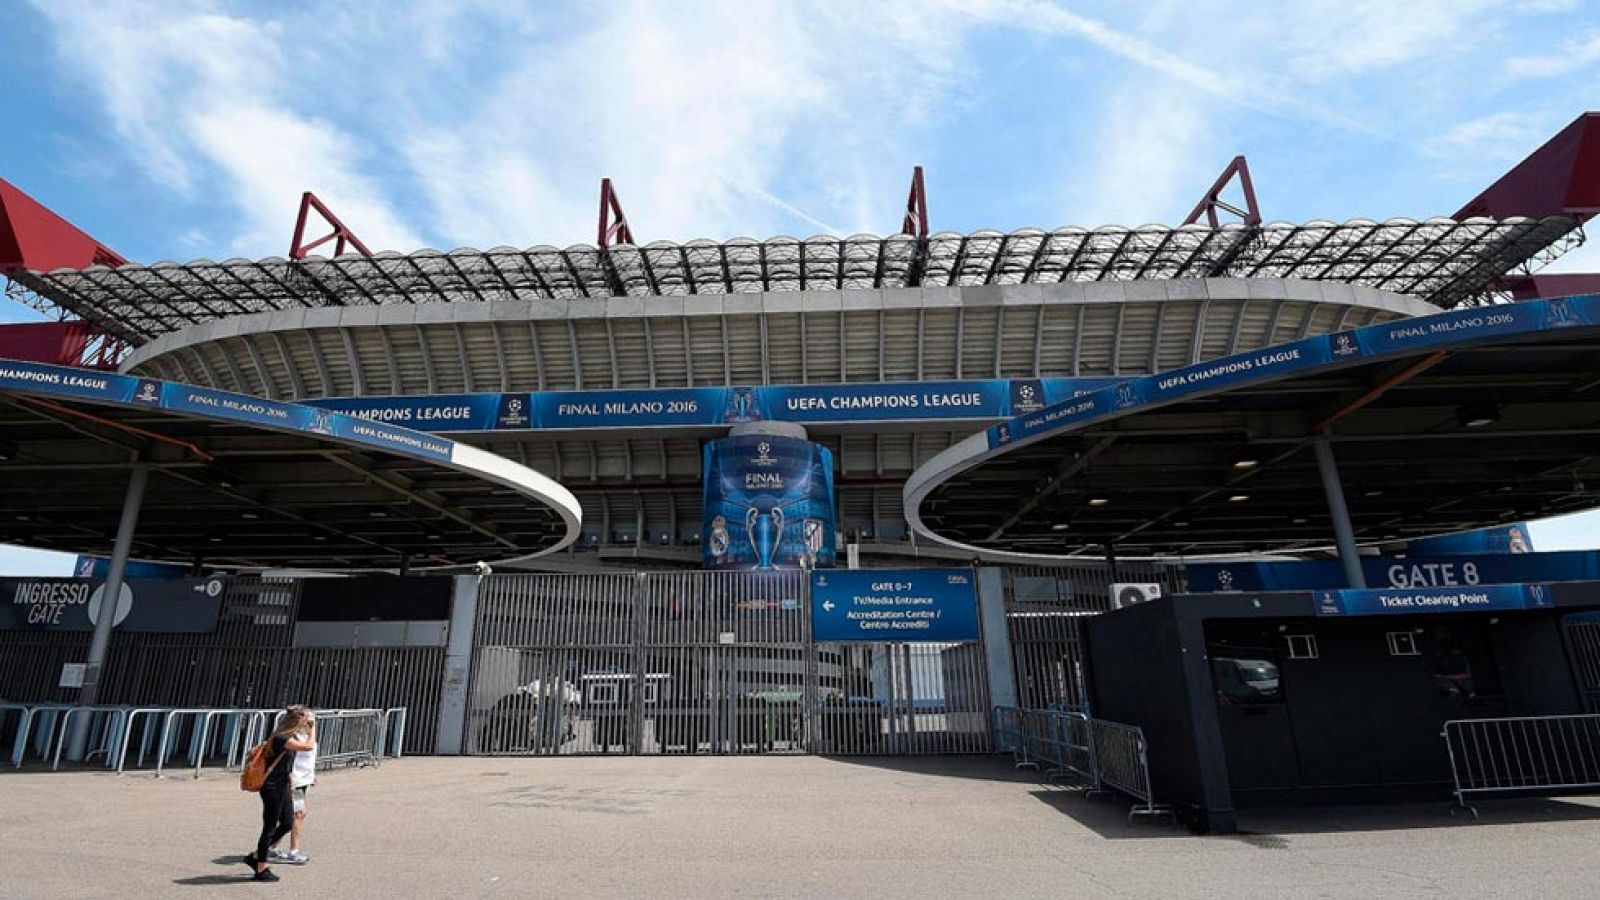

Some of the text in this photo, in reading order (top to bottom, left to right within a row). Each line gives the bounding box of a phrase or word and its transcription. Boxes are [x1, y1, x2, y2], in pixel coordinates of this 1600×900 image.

[1390, 313, 1514, 340] FINAL MILANO 2016
[1158, 349, 1300, 390] UEFA CHAMPIONS LEAGUE
[63, 376, 108, 390] LEAGUE
[189, 394, 288, 419] FINAL MILANO 2016
[558, 401, 698, 416] FINAL MILANO 2016
[788, 393, 981, 410] UEFA CHAMPIONS LEAGUE
[333, 407, 471, 421] AMPIONS LEAGUE
[745, 473, 783, 483] FINAL
[1388, 562, 1480, 588] GATE 8
[14, 583, 89, 604] INGRESSO
[871, 582, 894, 592] GATE
[895, 595, 933, 606] Entrance
[1379, 593, 1489, 607] Ticket Clearing Point
[27, 603, 65, 624] GATE
[847, 611, 905, 620] Accreditation
[906, 610, 934, 619] Centre
